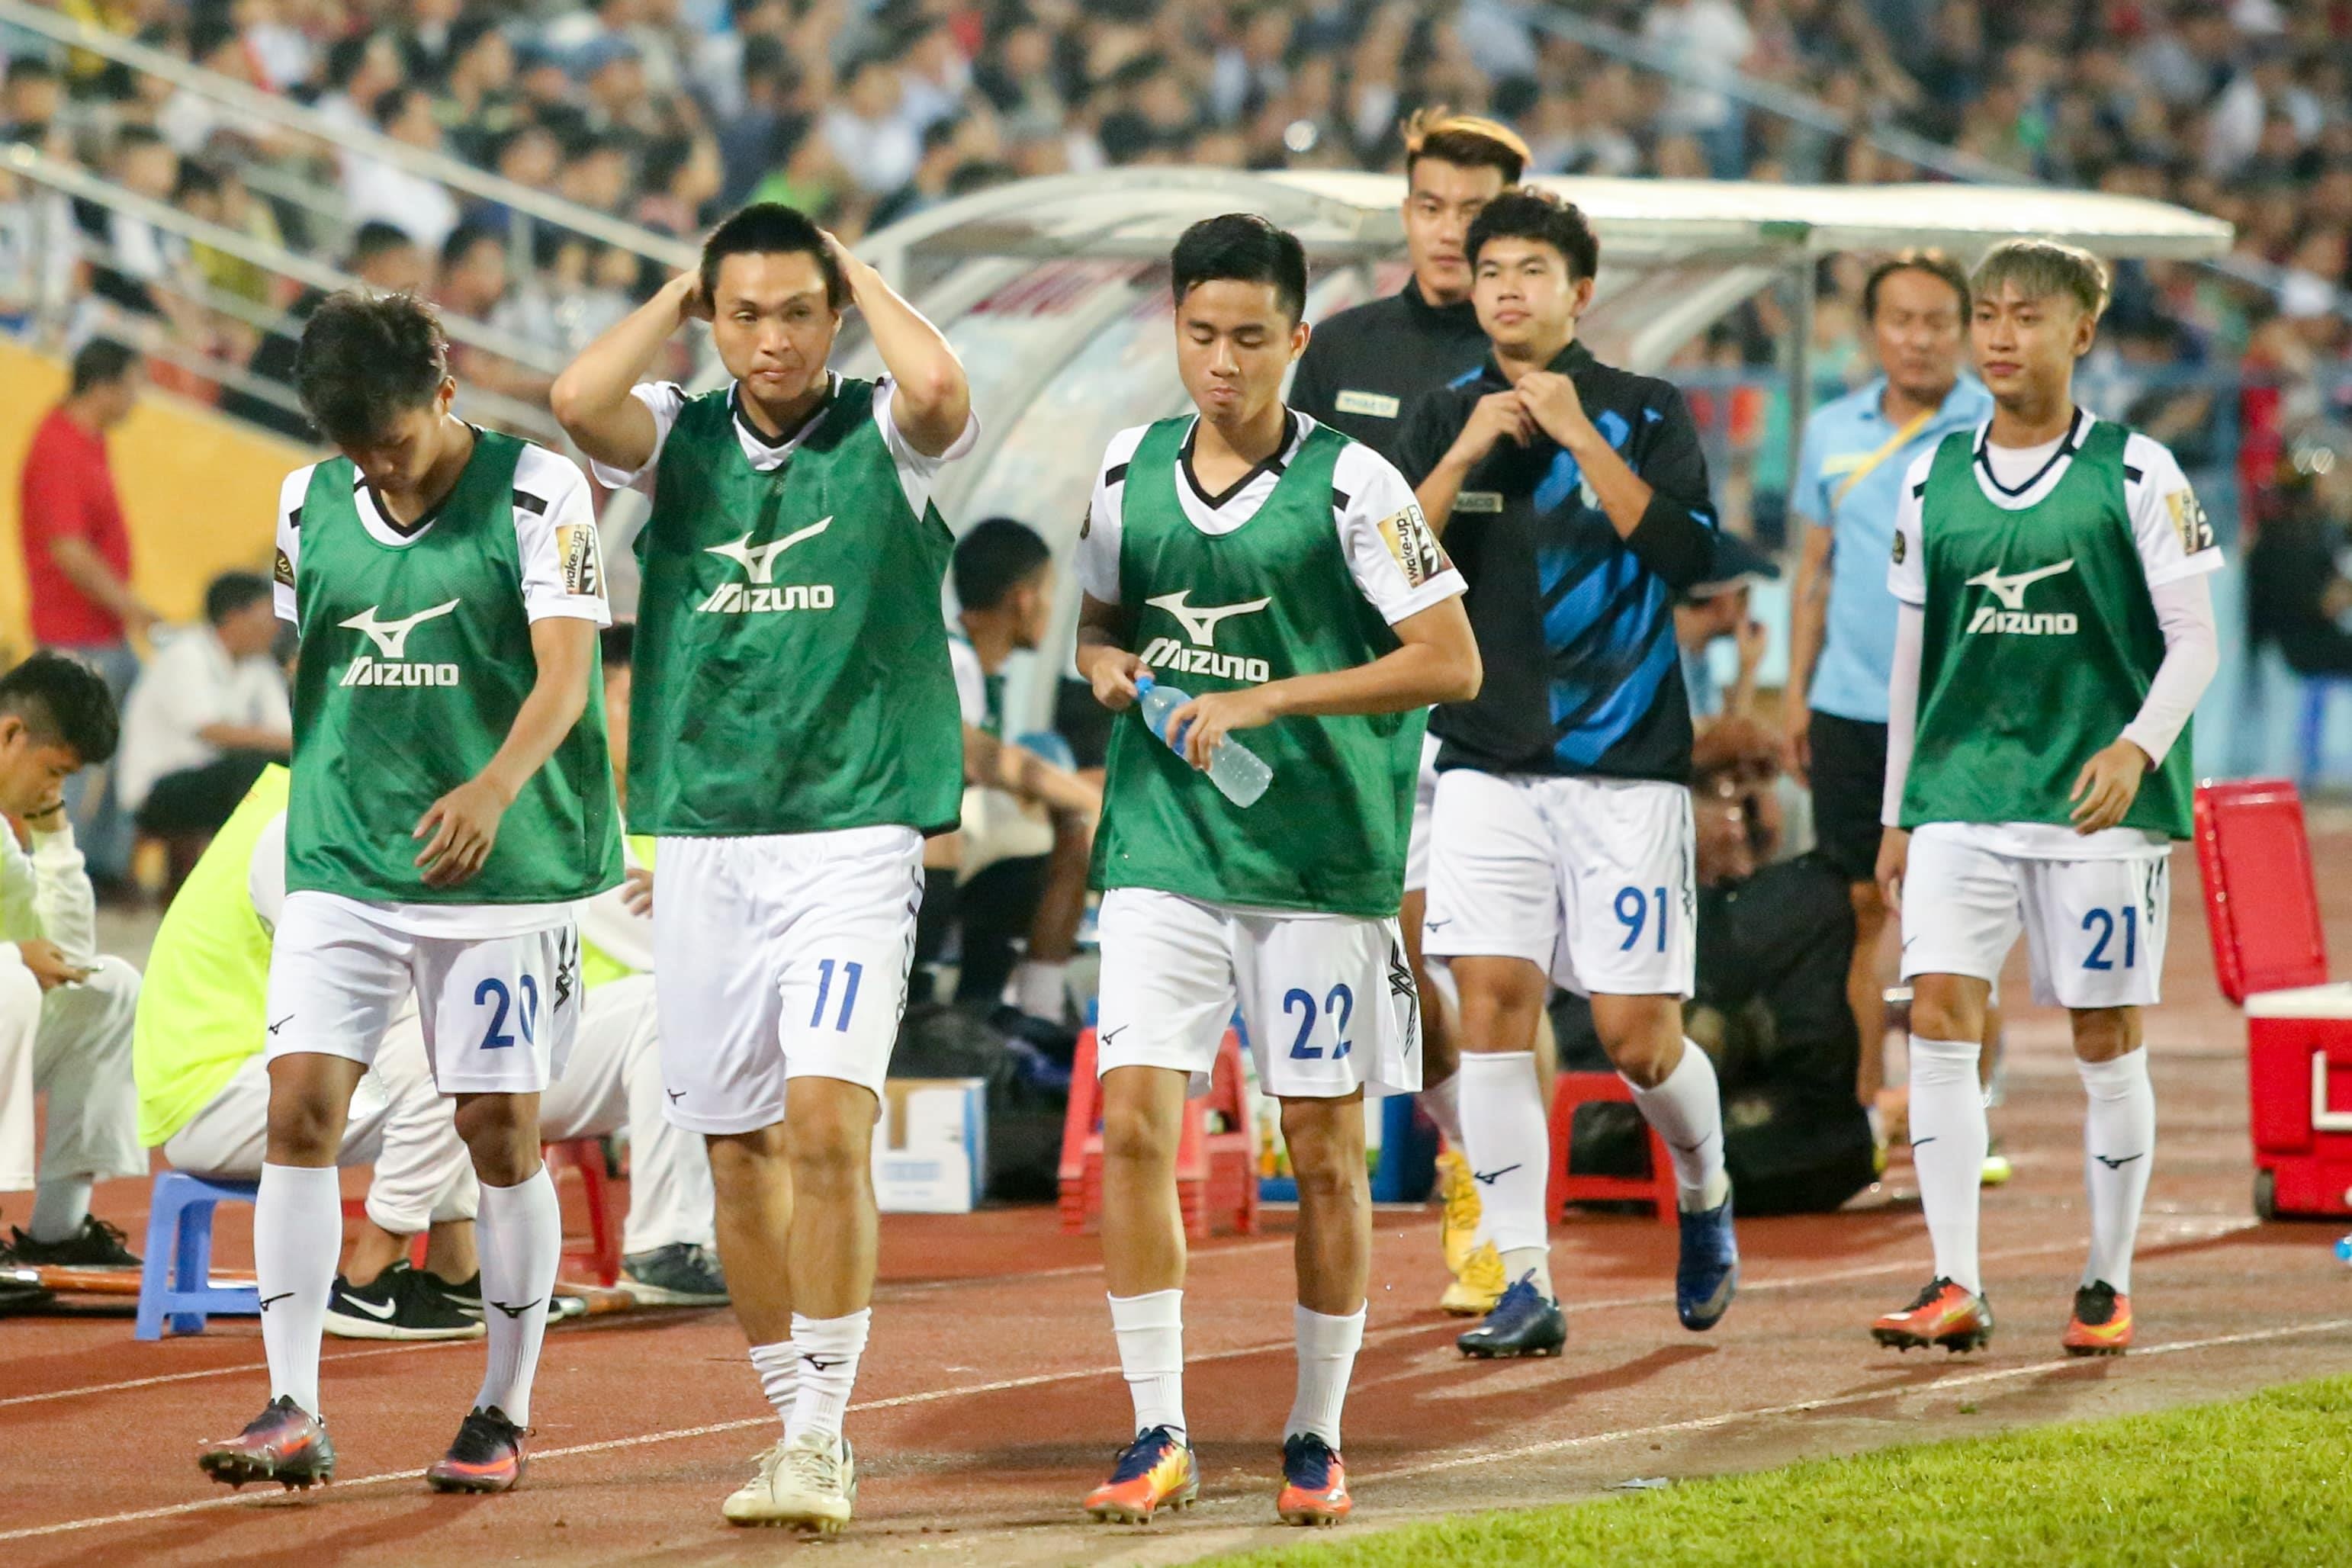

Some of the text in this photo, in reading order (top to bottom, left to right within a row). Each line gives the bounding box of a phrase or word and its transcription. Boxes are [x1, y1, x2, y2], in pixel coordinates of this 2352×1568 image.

[565, 531, 584, 588] wake-up
[1396, 518, 1419, 580] wake-up
[1614, 886, 1667, 953] 91
[2081, 905, 2135, 970] 21
[474, 974, 538, 1050] 20
[810, 959, 863, 1033] 11
[1284, 983, 1353, 1059] 22
